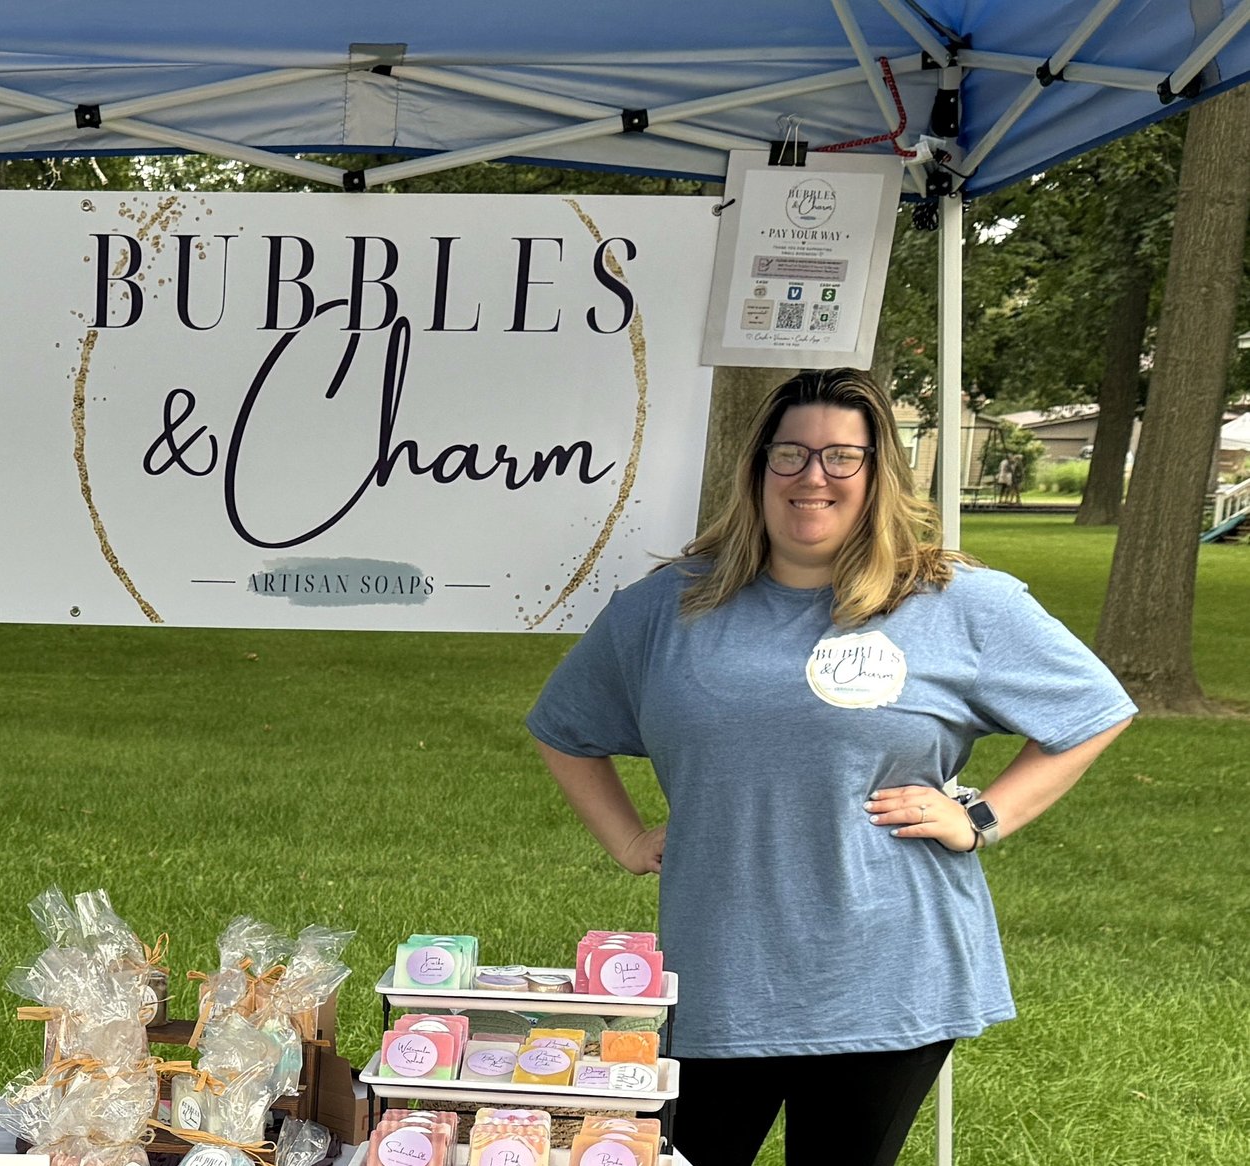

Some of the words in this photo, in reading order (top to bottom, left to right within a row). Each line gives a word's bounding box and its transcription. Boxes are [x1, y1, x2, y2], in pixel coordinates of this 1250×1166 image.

[788, 188, 837, 200] BUBBLES
[768, 228, 788, 239] PAY
[791, 229, 818, 240] YOUR
[821, 231, 842, 241] WAY
[88, 233, 638, 334] BUBBLES
[143, 388, 219, 478] &
[224, 298, 616, 549] Charm
[246, 574, 350, 595] ARTISAN
[359, 575, 435, 596] SOAPS
[820, 663, 835, 675] &
[832, 652, 895, 685] Charm
[498, 1150, 520, 1166] Pink
